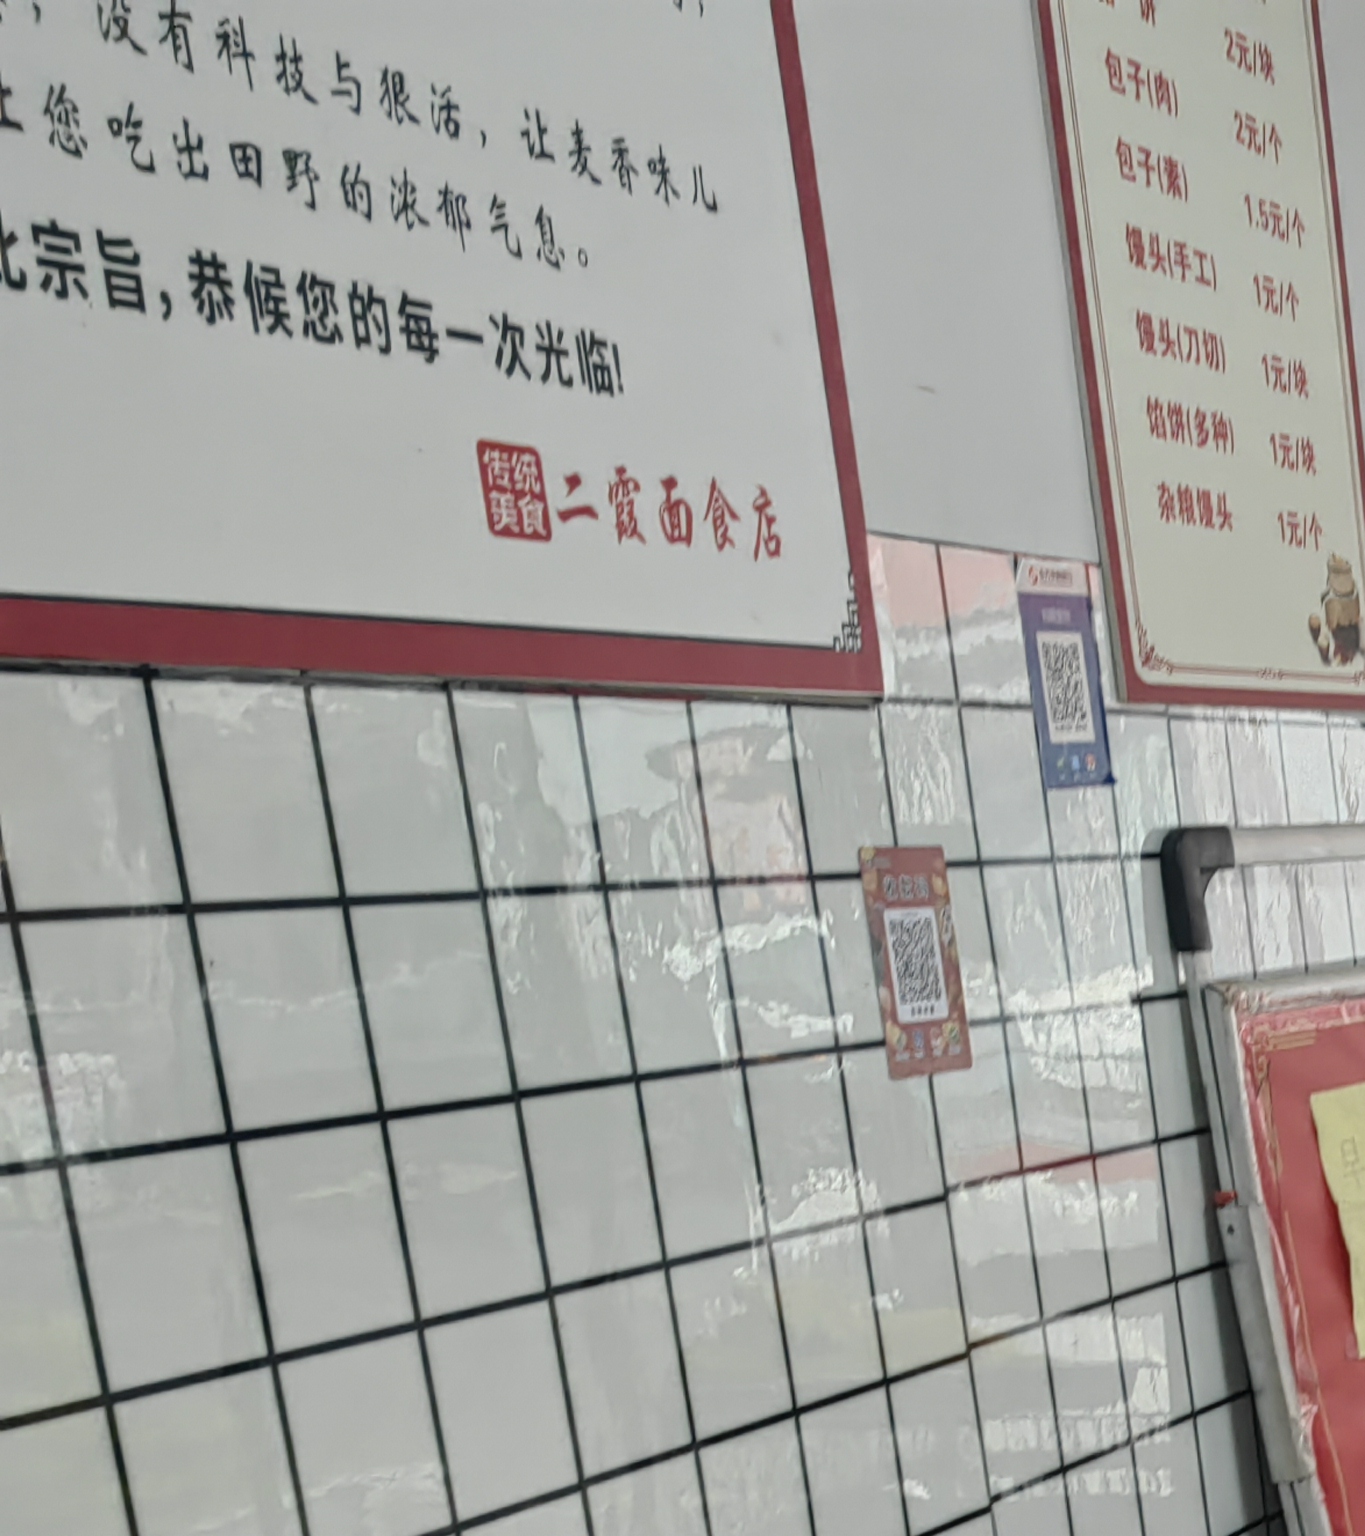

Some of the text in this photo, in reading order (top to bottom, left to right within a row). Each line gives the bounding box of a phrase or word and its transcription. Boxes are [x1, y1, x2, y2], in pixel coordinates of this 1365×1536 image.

[1105, 46, 1282, 165] 包子(肉) 2元/个
[1116, 136, 1305, 248] 包子(素) 1.5元/个
[1253, 273, 1299, 322] 1元/个
[556, 465, 781, 562] 二霞面食店
[1278, 511, 1323, 551] 1元/个
